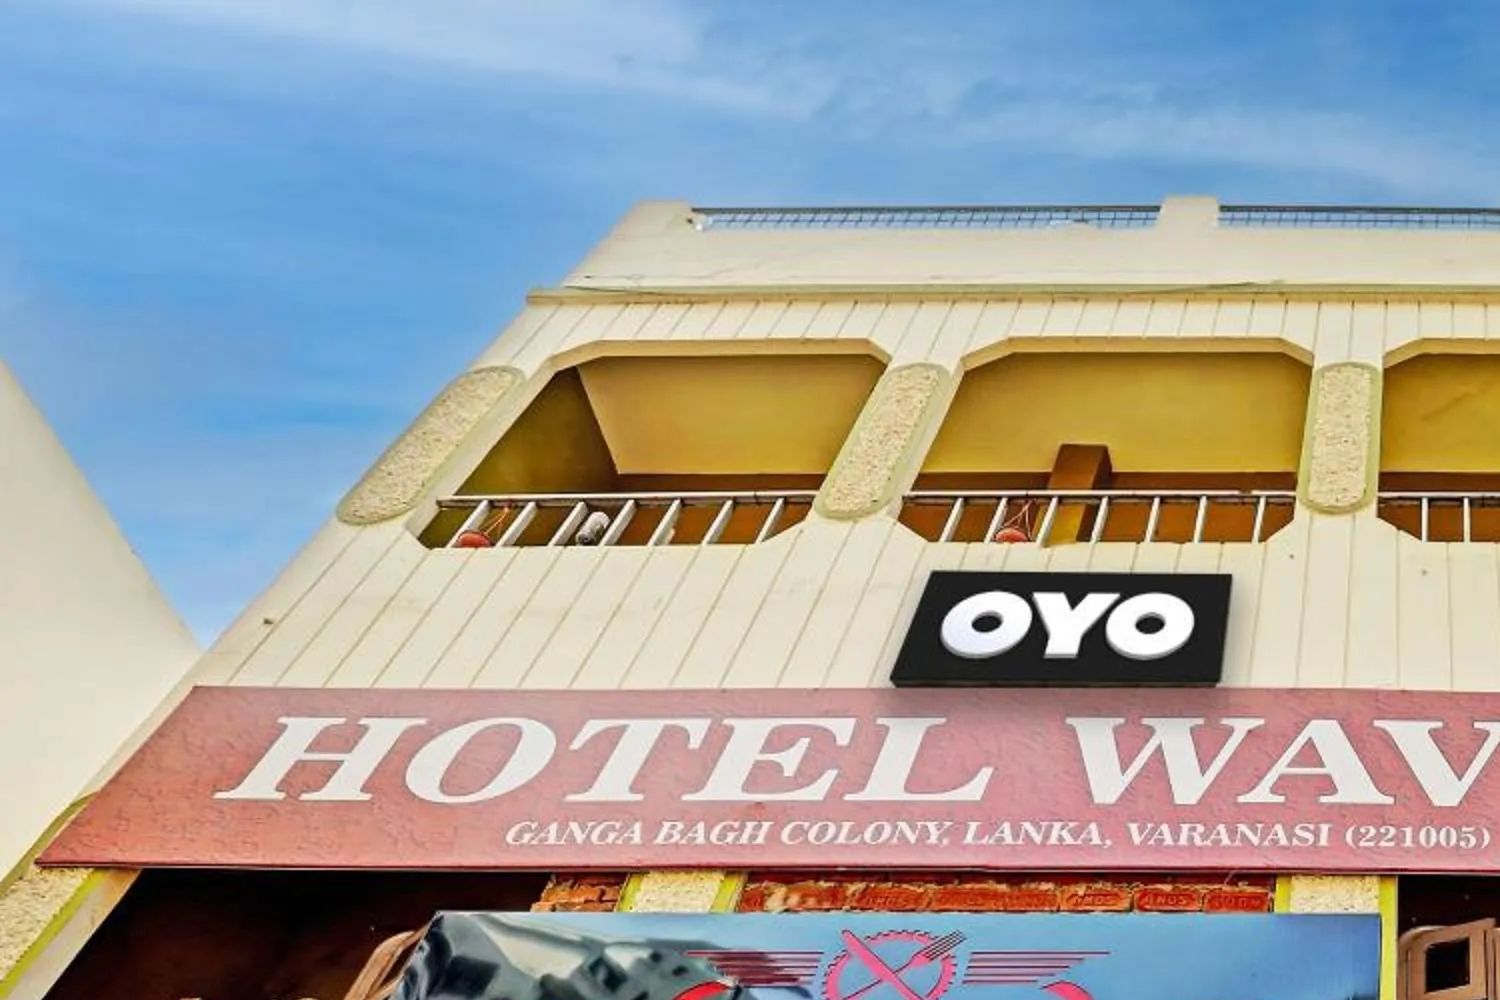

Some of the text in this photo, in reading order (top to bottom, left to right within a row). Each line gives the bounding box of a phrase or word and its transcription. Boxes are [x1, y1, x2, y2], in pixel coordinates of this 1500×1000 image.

[941, 590, 1195, 660] OYO
[213, 716, 994, 804] HOTEL
[505, 820, 643, 846] GANGA
[653, 820, 774, 846] BAGH
[962, 820, 1112, 849] LANKA,
[1126, 821, 1333, 847] VARANASI
[1344, 825, 1491, 849] (221005)
